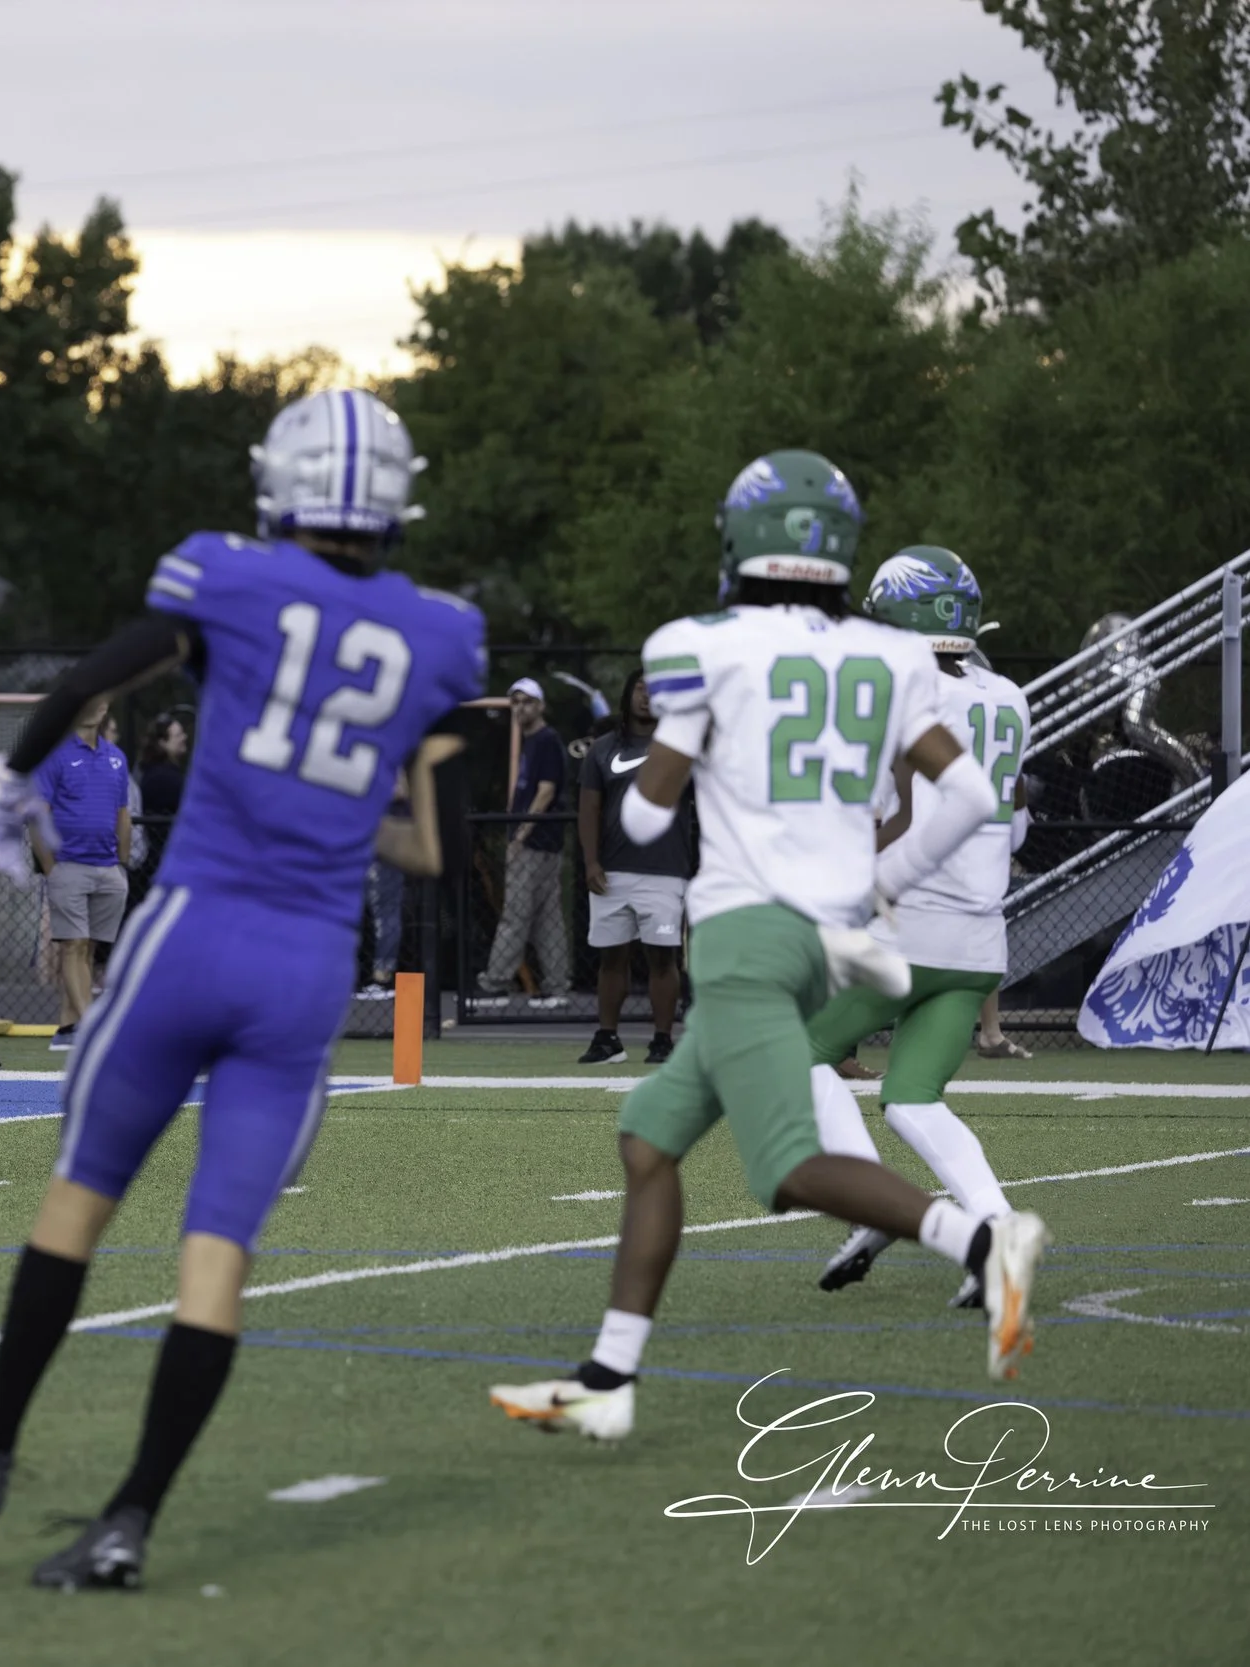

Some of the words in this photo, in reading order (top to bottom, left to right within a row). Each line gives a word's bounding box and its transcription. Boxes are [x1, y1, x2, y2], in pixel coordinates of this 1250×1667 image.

[237, 601, 413, 799] 12
[768, 655, 893, 803] 29
[967, 702, 1023, 824] 12
